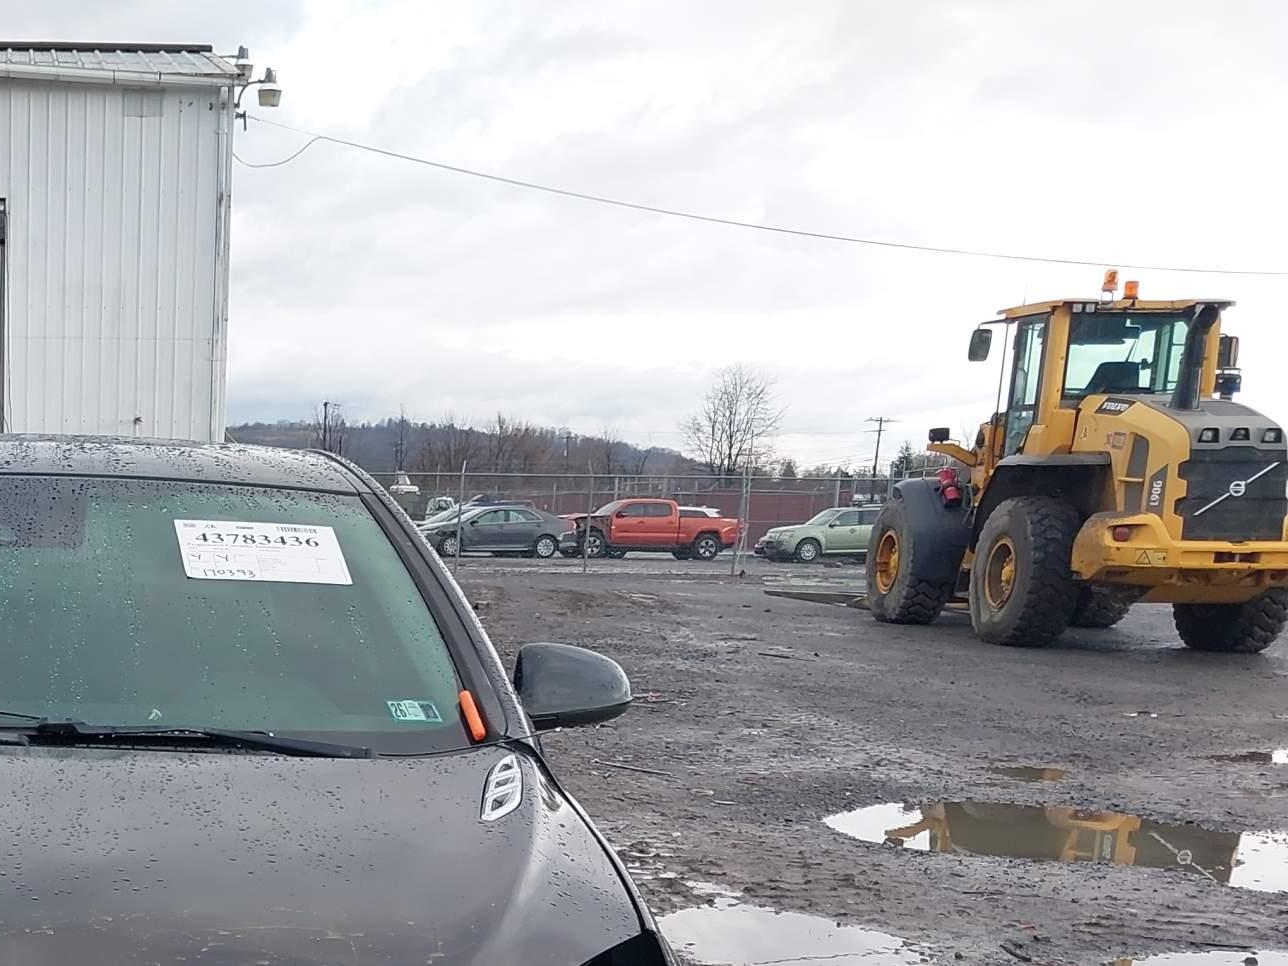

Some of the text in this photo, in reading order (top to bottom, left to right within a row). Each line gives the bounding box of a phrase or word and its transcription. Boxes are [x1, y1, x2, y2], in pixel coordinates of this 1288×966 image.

[1102, 401, 1129, 411] VOLVO
[1149, 480, 1162, 506] L90G
[195, 532, 320, 548] 43783436
[390, 702, 407, 717] 26
